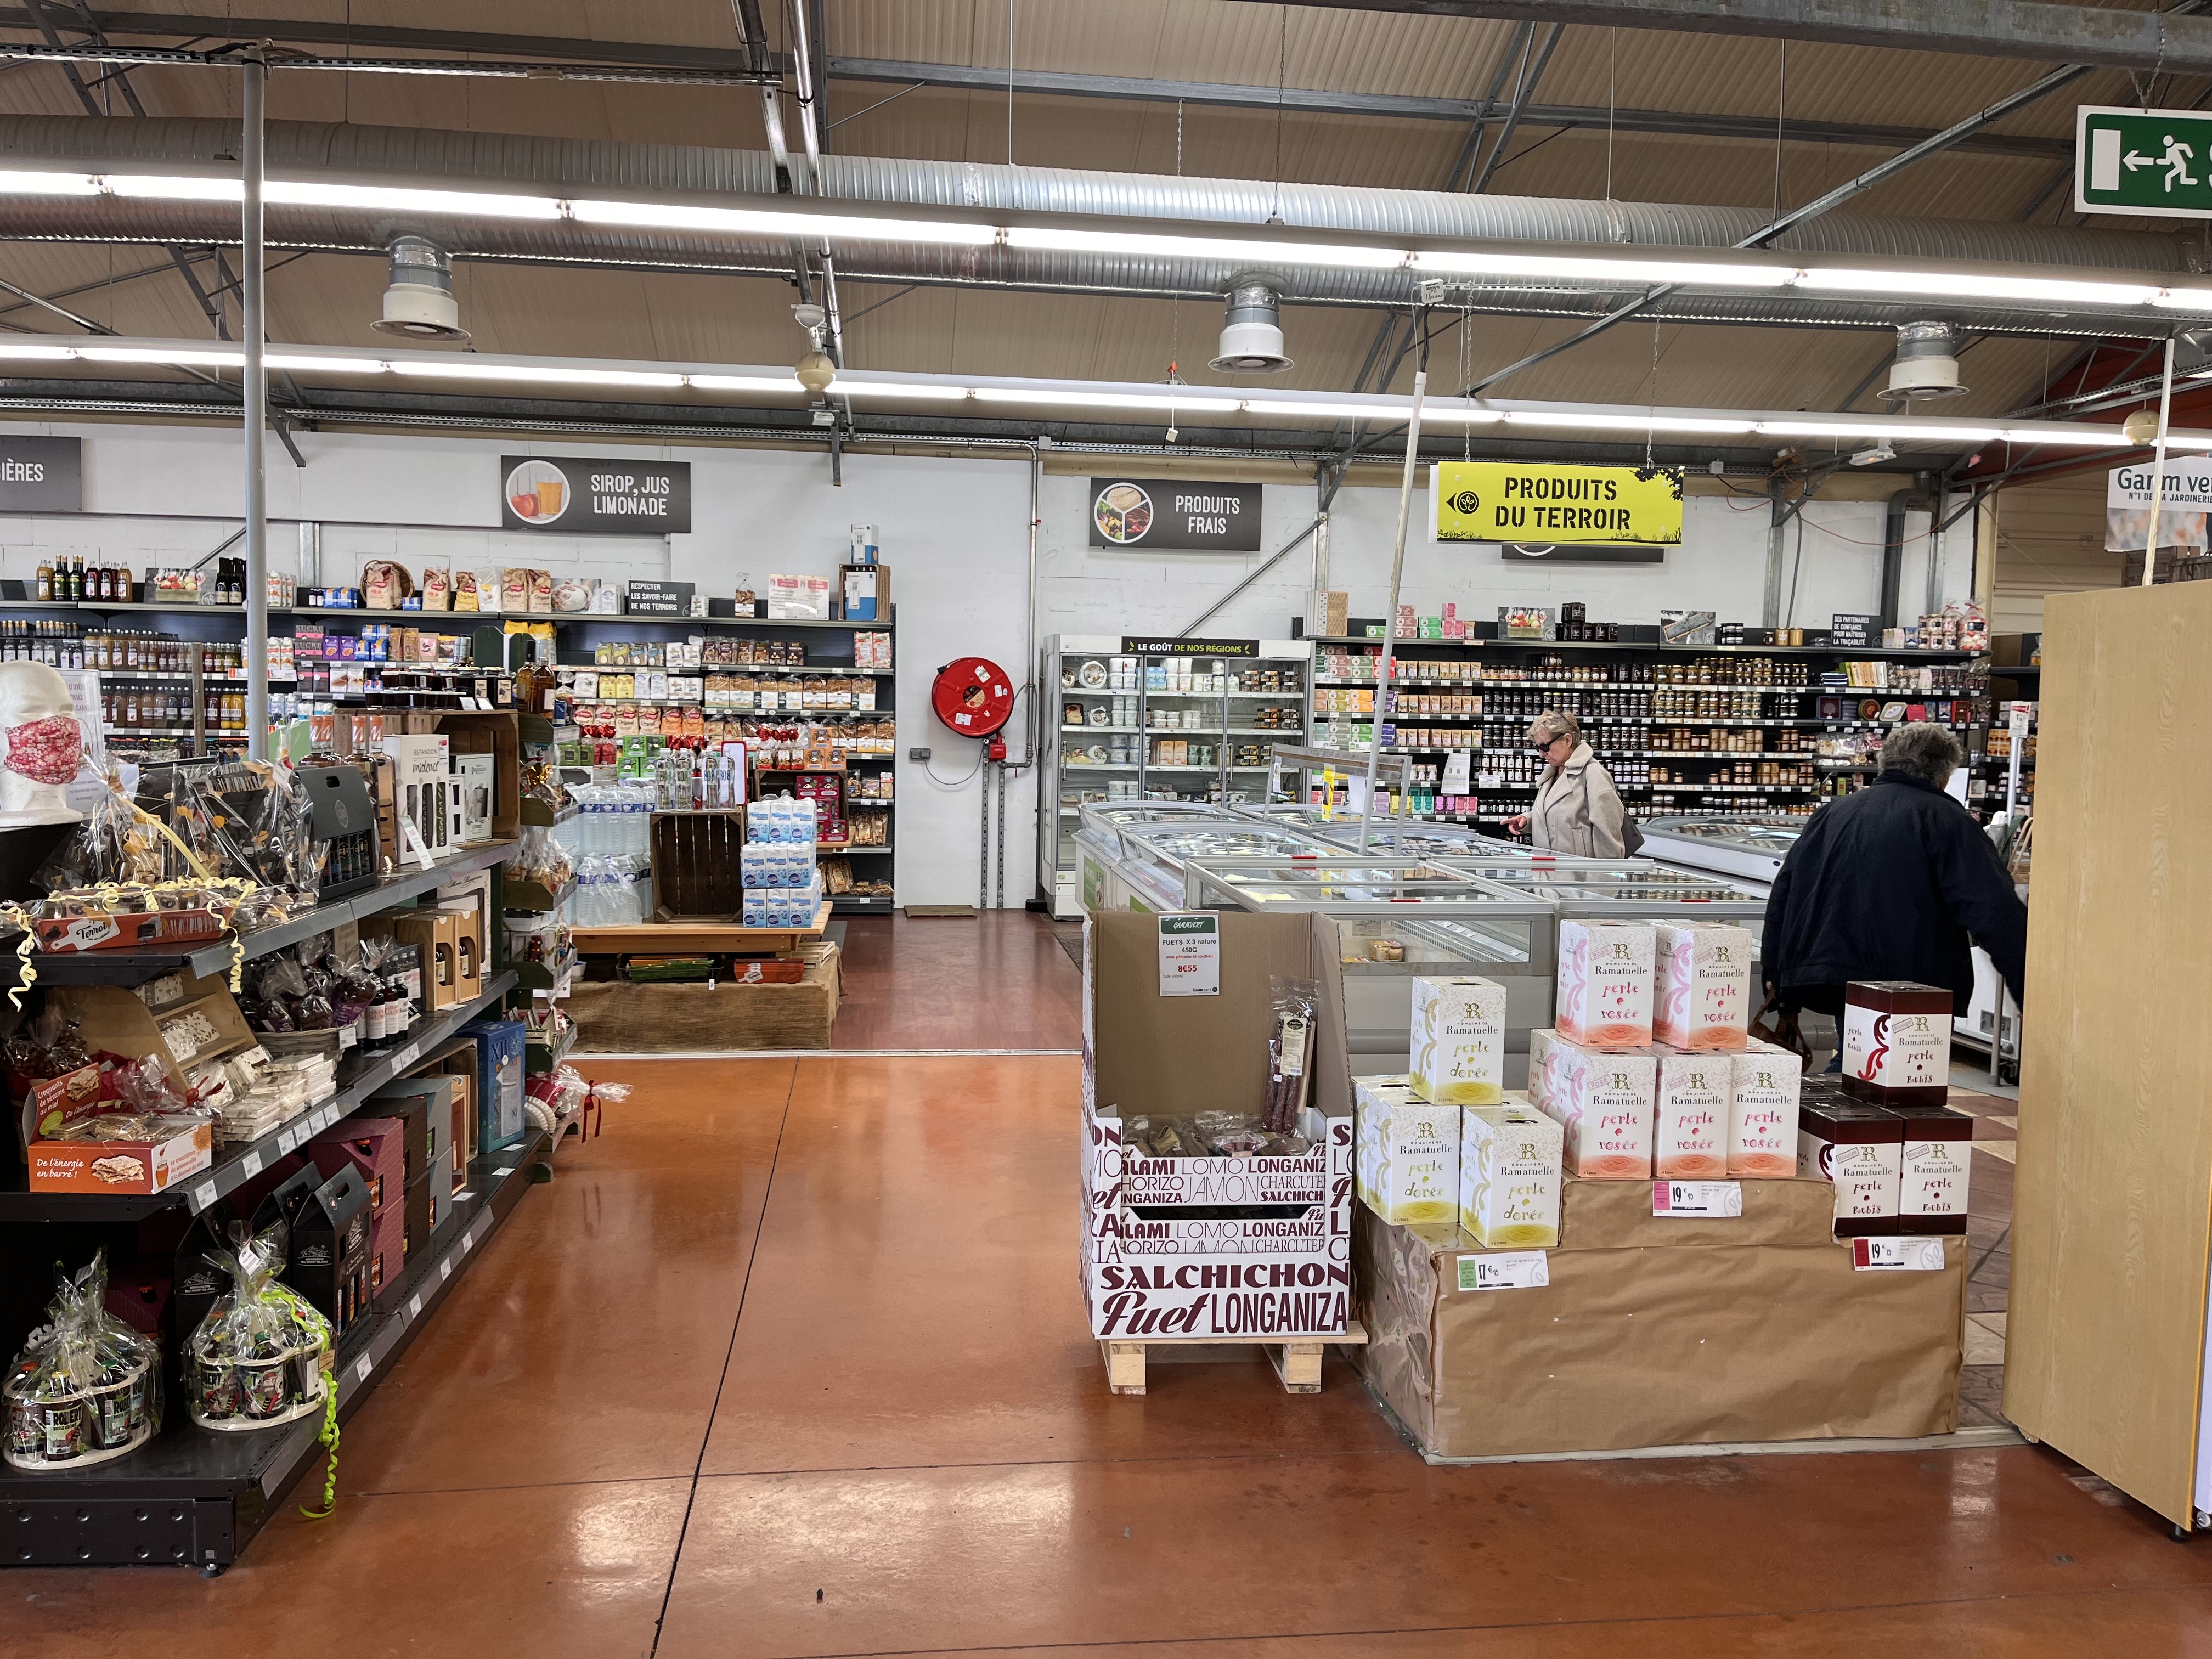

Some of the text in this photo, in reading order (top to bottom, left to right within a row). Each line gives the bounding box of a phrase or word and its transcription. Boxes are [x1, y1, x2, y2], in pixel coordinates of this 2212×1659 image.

[0, 458, 43, 482] IÈRES
[591, 474, 670, 496] SIROP, JUS
[1504, 477, 1617, 501] PRODUITS
[2187, 476, 2212, 493] ve
[594, 495, 667, 516] LIMONADE
[1175, 495, 1240, 514] PRODUITS
[2169, 494, 2212, 504] JARDINERIE
[1188, 516, 1227, 534] FRAIS
[1495, 506, 1631, 530] DU TERROIR
[1149, 642, 1172, 651] GOÛT
[1206, 644, 1242, 653] RÉGIONS
[76, 922, 106, 940] Terroi
[1595, 966, 1647, 975] Ramatuelle
[1699, 969, 1745, 978] Ramatuelle
[1602, 981, 1639, 997] perle
[1705, 984, 1737, 1001] perle
[1601, 1009, 1638, 1019] rosée
[1703, 1011, 1736, 1022] rosée
[1446, 1025, 1498, 1034] Ramatuelle
[1453, 1041, 1489, 1057] perle
[1899, 1037, 1943, 1046] Ramatuelle
[1906, 1049, 1934, 1064] perle
[1449, 1062, 1489, 1078] dorée
[37, 1080, 63, 1099] Croquants
[40, 1088, 65, 1108] de sésame
[48, 1099, 59, 1111] miel
[1593, 1096, 1647, 1105] Ramatuelle
[1671, 1096, 1723, 1105] Ramatuelle
[1737, 1093, 1792, 1104] Ramatuelle
[1600, 1112, 1638, 1128] perle
[1678, 1111, 1714, 1128] perle
[1743, 1111, 1782, 1126] perle
[1332, 1124, 1353, 1146] S
[1400, 1144, 1452, 1154] Ramatuelle
[1598, 1140, 1638, 1150] rosée
[1676, 1138, 1714, 1150] rosée
[1742, 1138, 1782, 1148] rosée
[37, 1158, 84, 1172] De l'énergie
[1182, 1158, 1243, 1175] LOMO
[1408, 1160, 1444, 1177] perle
[1500, 1166, 1554, 1176] Ramatuelle
[1843, 1167, 1892, 1177] Ramatuelle
[1914, 1164, 1962, 1174] Ramatuelle
[49, 1170, 73, 1178] barre
[1260, 1175, 1325, 1189] CHARCUTE
[1404, 1181, 1443, 1198] dorée
[1852, 1180, 1882, 1194] perle
[1922, 1177, 1952, 1192] perle
[1260, 1190, 1325, 1202] SALCHICH
[1508, 1182, 1545, 1199] perle
[1673, 1187, 1681, 1203] 19
[1503, 1204, 1545, 1221] dorée
[1177, 1222, 1238, 1239] LOMO
[1871, 1243, 1880, 1259] 19
[1101, 1262, 1348, 1290] SALCHICHON
[1487, 1265, 1493, 1273] €
[1099, 1290, 1348, 1336] Fuet LONGANIZA
